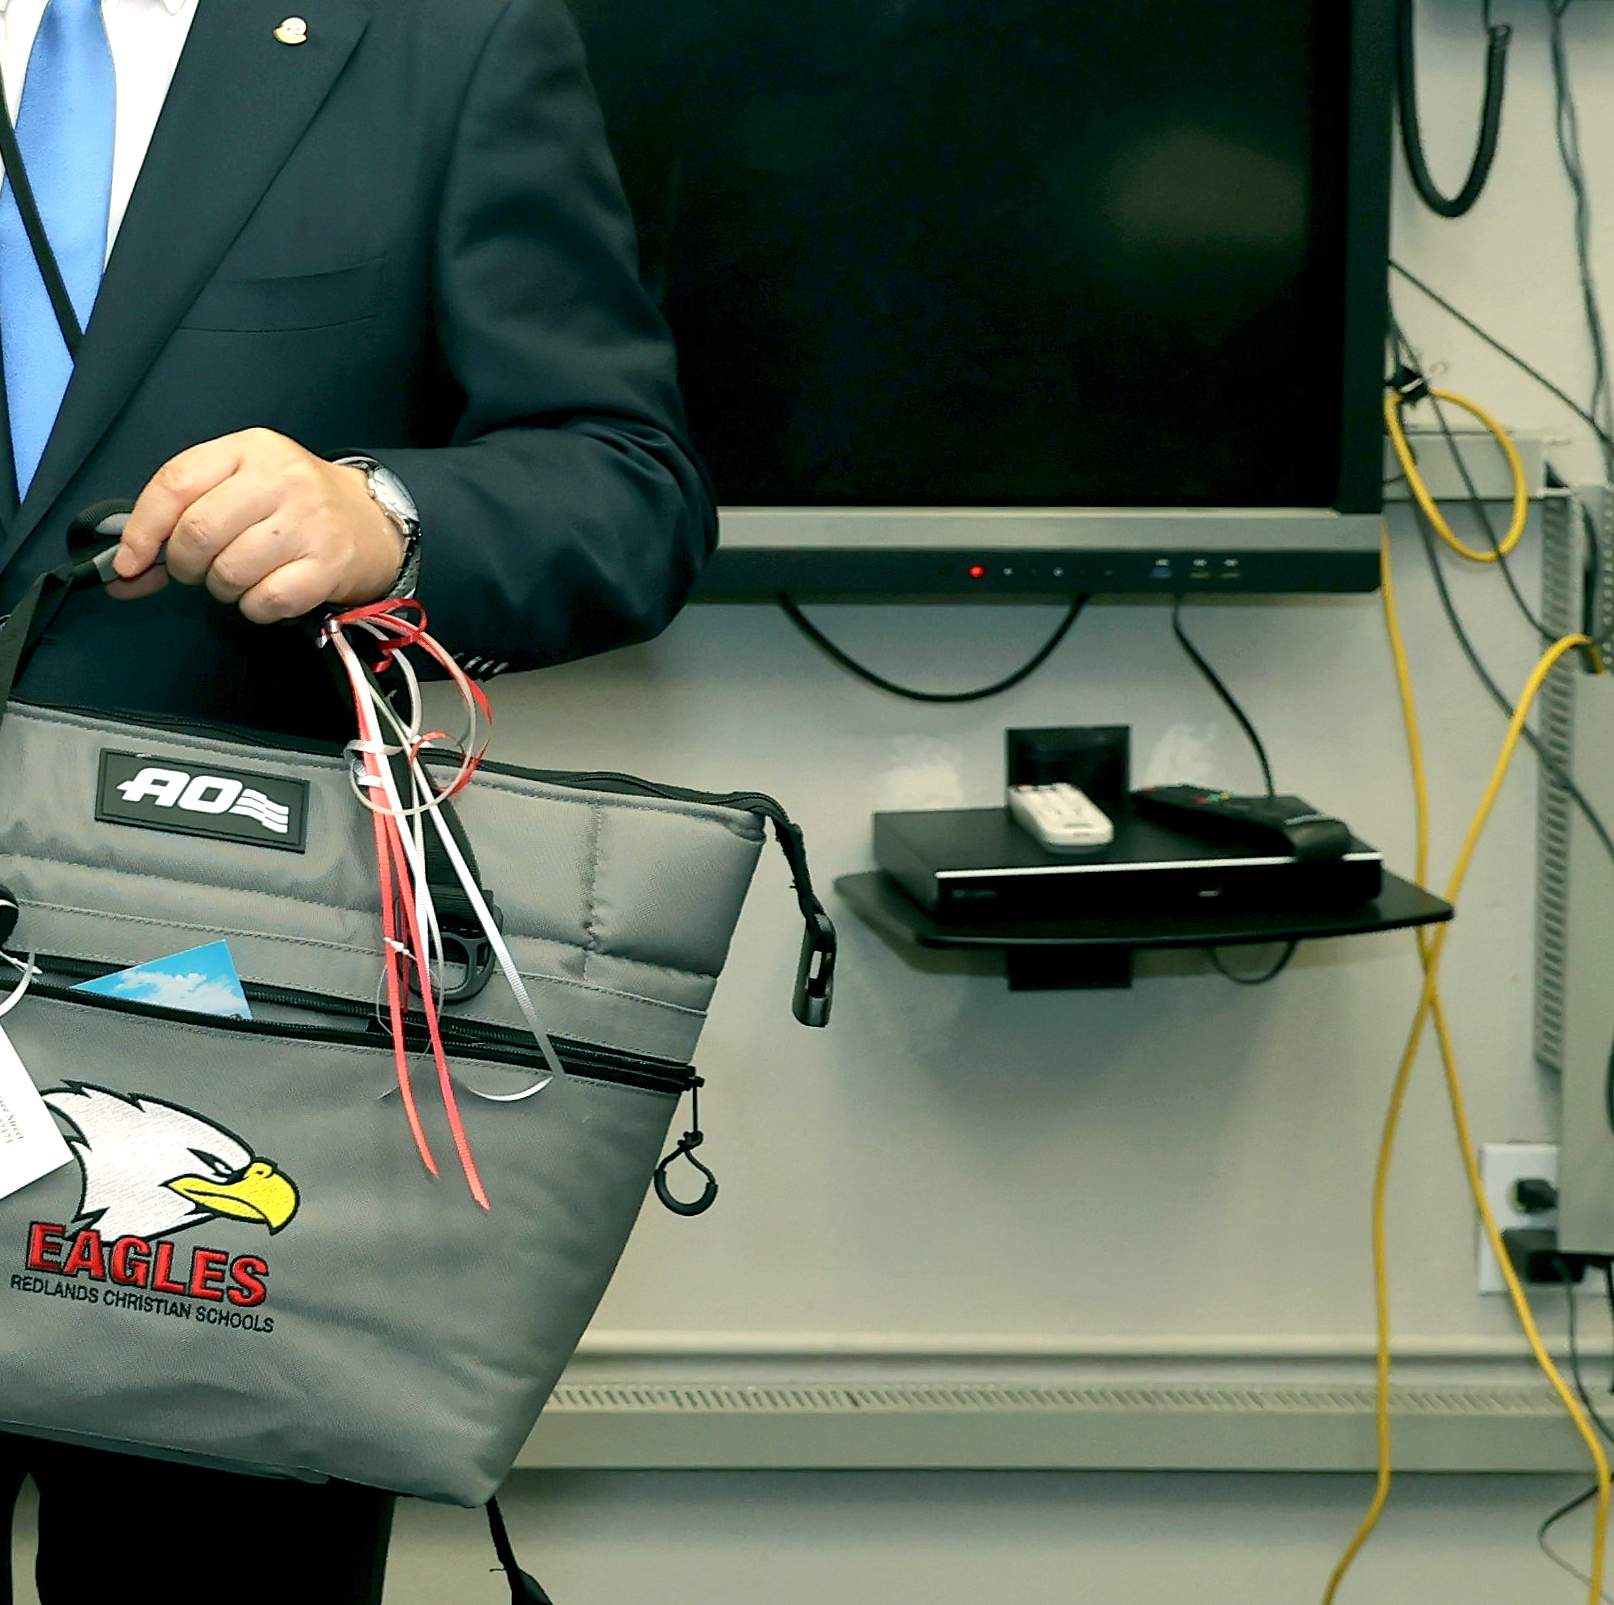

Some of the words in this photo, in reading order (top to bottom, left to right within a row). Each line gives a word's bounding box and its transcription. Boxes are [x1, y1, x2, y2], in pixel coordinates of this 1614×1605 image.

[116, 767, 242, 814] AO
[6, 1114, 25, 1140] Street
[25, 1221, 269, 1307] EAGLES
[10, 1273, 100, 1306] REDLANDS
[103, 1288, 192, 1320] CHRISTIAN
[196, 1305, 275, 1333] SCHOOLS
